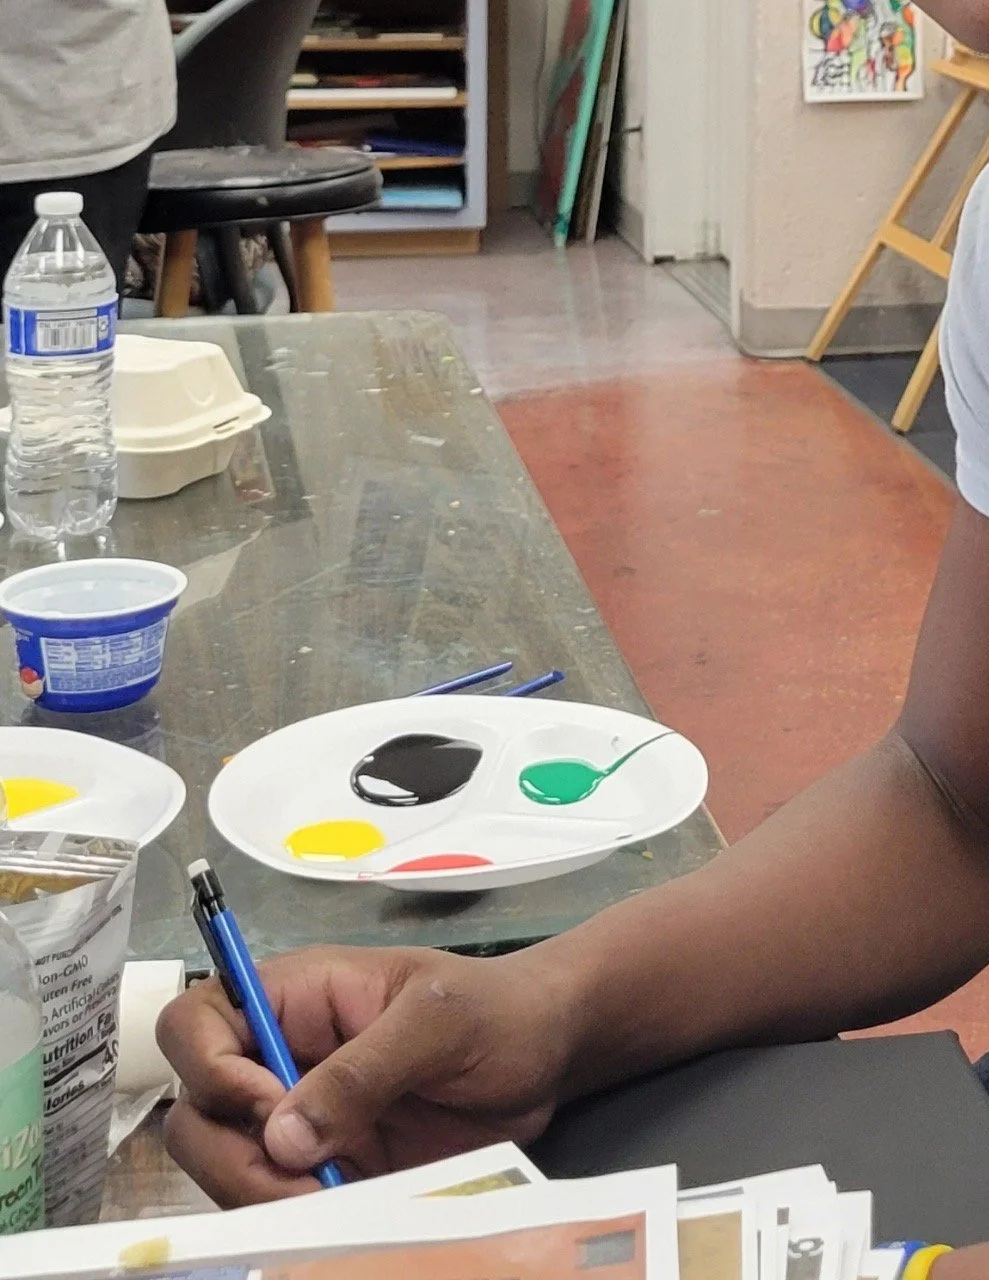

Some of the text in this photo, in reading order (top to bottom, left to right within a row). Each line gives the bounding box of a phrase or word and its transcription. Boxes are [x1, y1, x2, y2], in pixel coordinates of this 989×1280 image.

[39, 954, 89, 985] on-GMO
[42, 986, 69, 1003] uten
[52, 987, 96, 1020] Artificial
[43, 1017, 70, 1038] avors
[43, 1025, 94, 1065] utrition
[43, 1079, 85, 1110] lories
